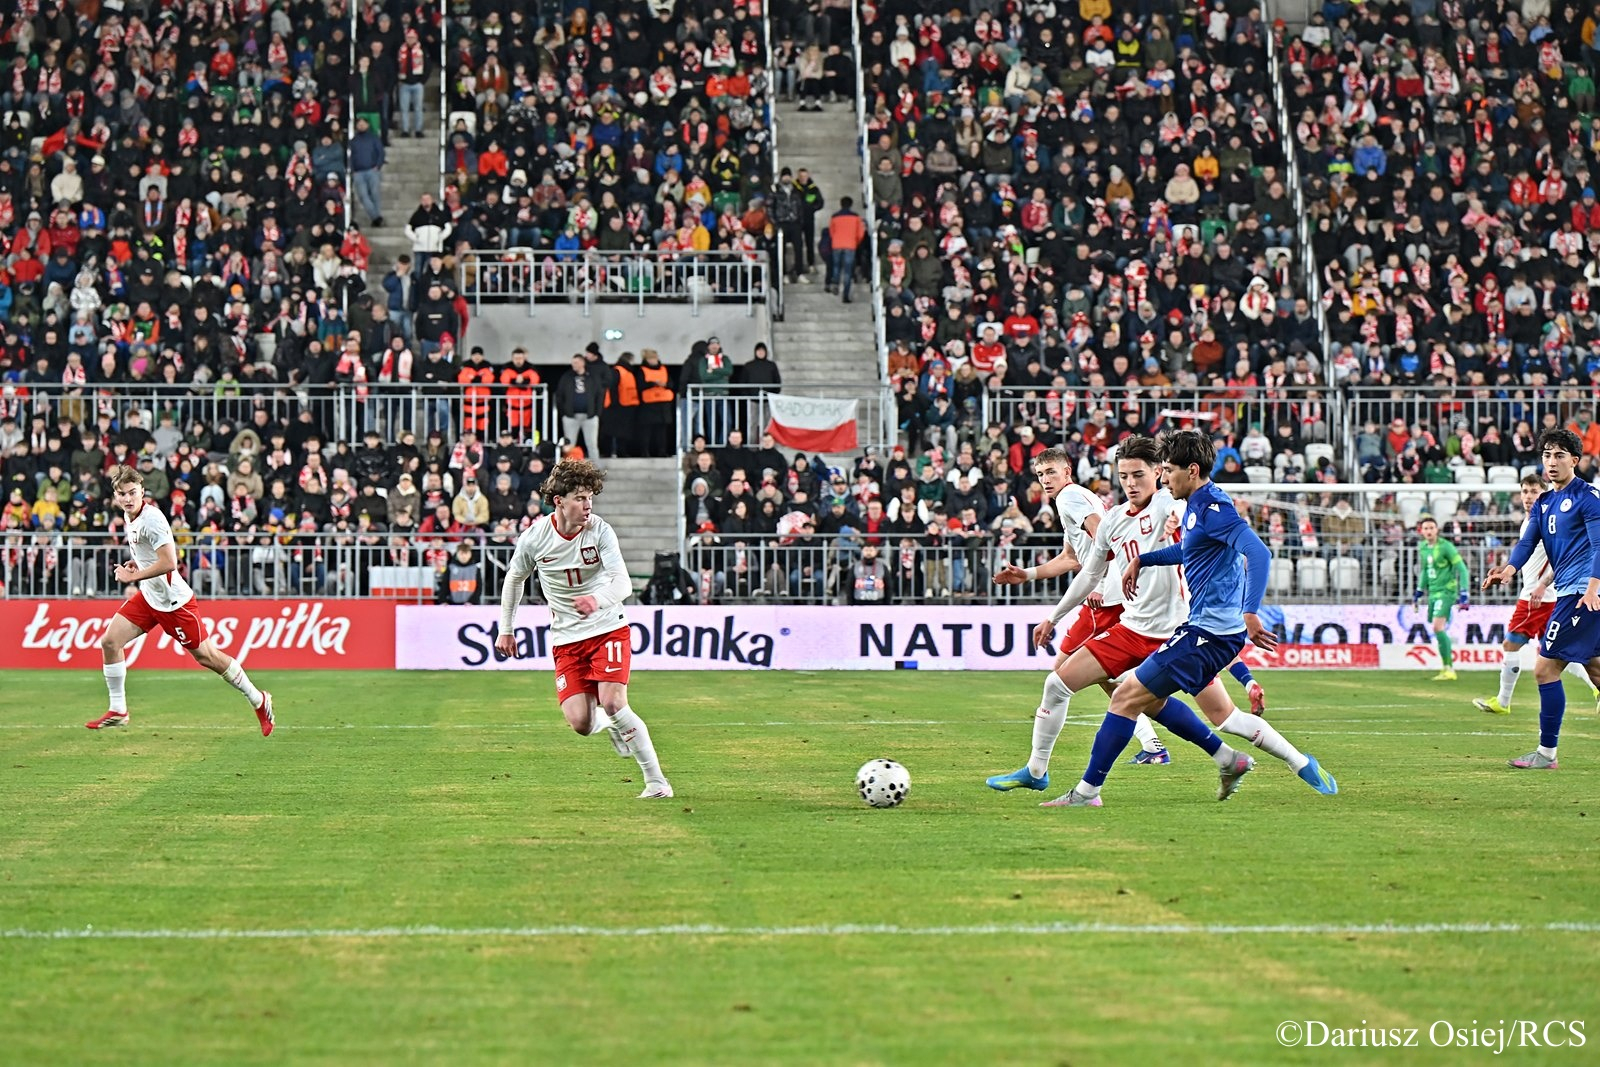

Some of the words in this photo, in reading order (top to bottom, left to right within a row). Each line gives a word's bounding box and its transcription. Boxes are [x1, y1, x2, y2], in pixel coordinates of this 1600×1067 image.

[1547, 514, 1557, 535] 8
[1121, 540, 1140, 564] 10
[563, 567, 582, 587] 11
[174, 626, 187, 641] 5
[1546, 620, 1560, 641] 8
[605, 640, 622, 664] 11
[1283, 647, 1352, 665] ORLEN
